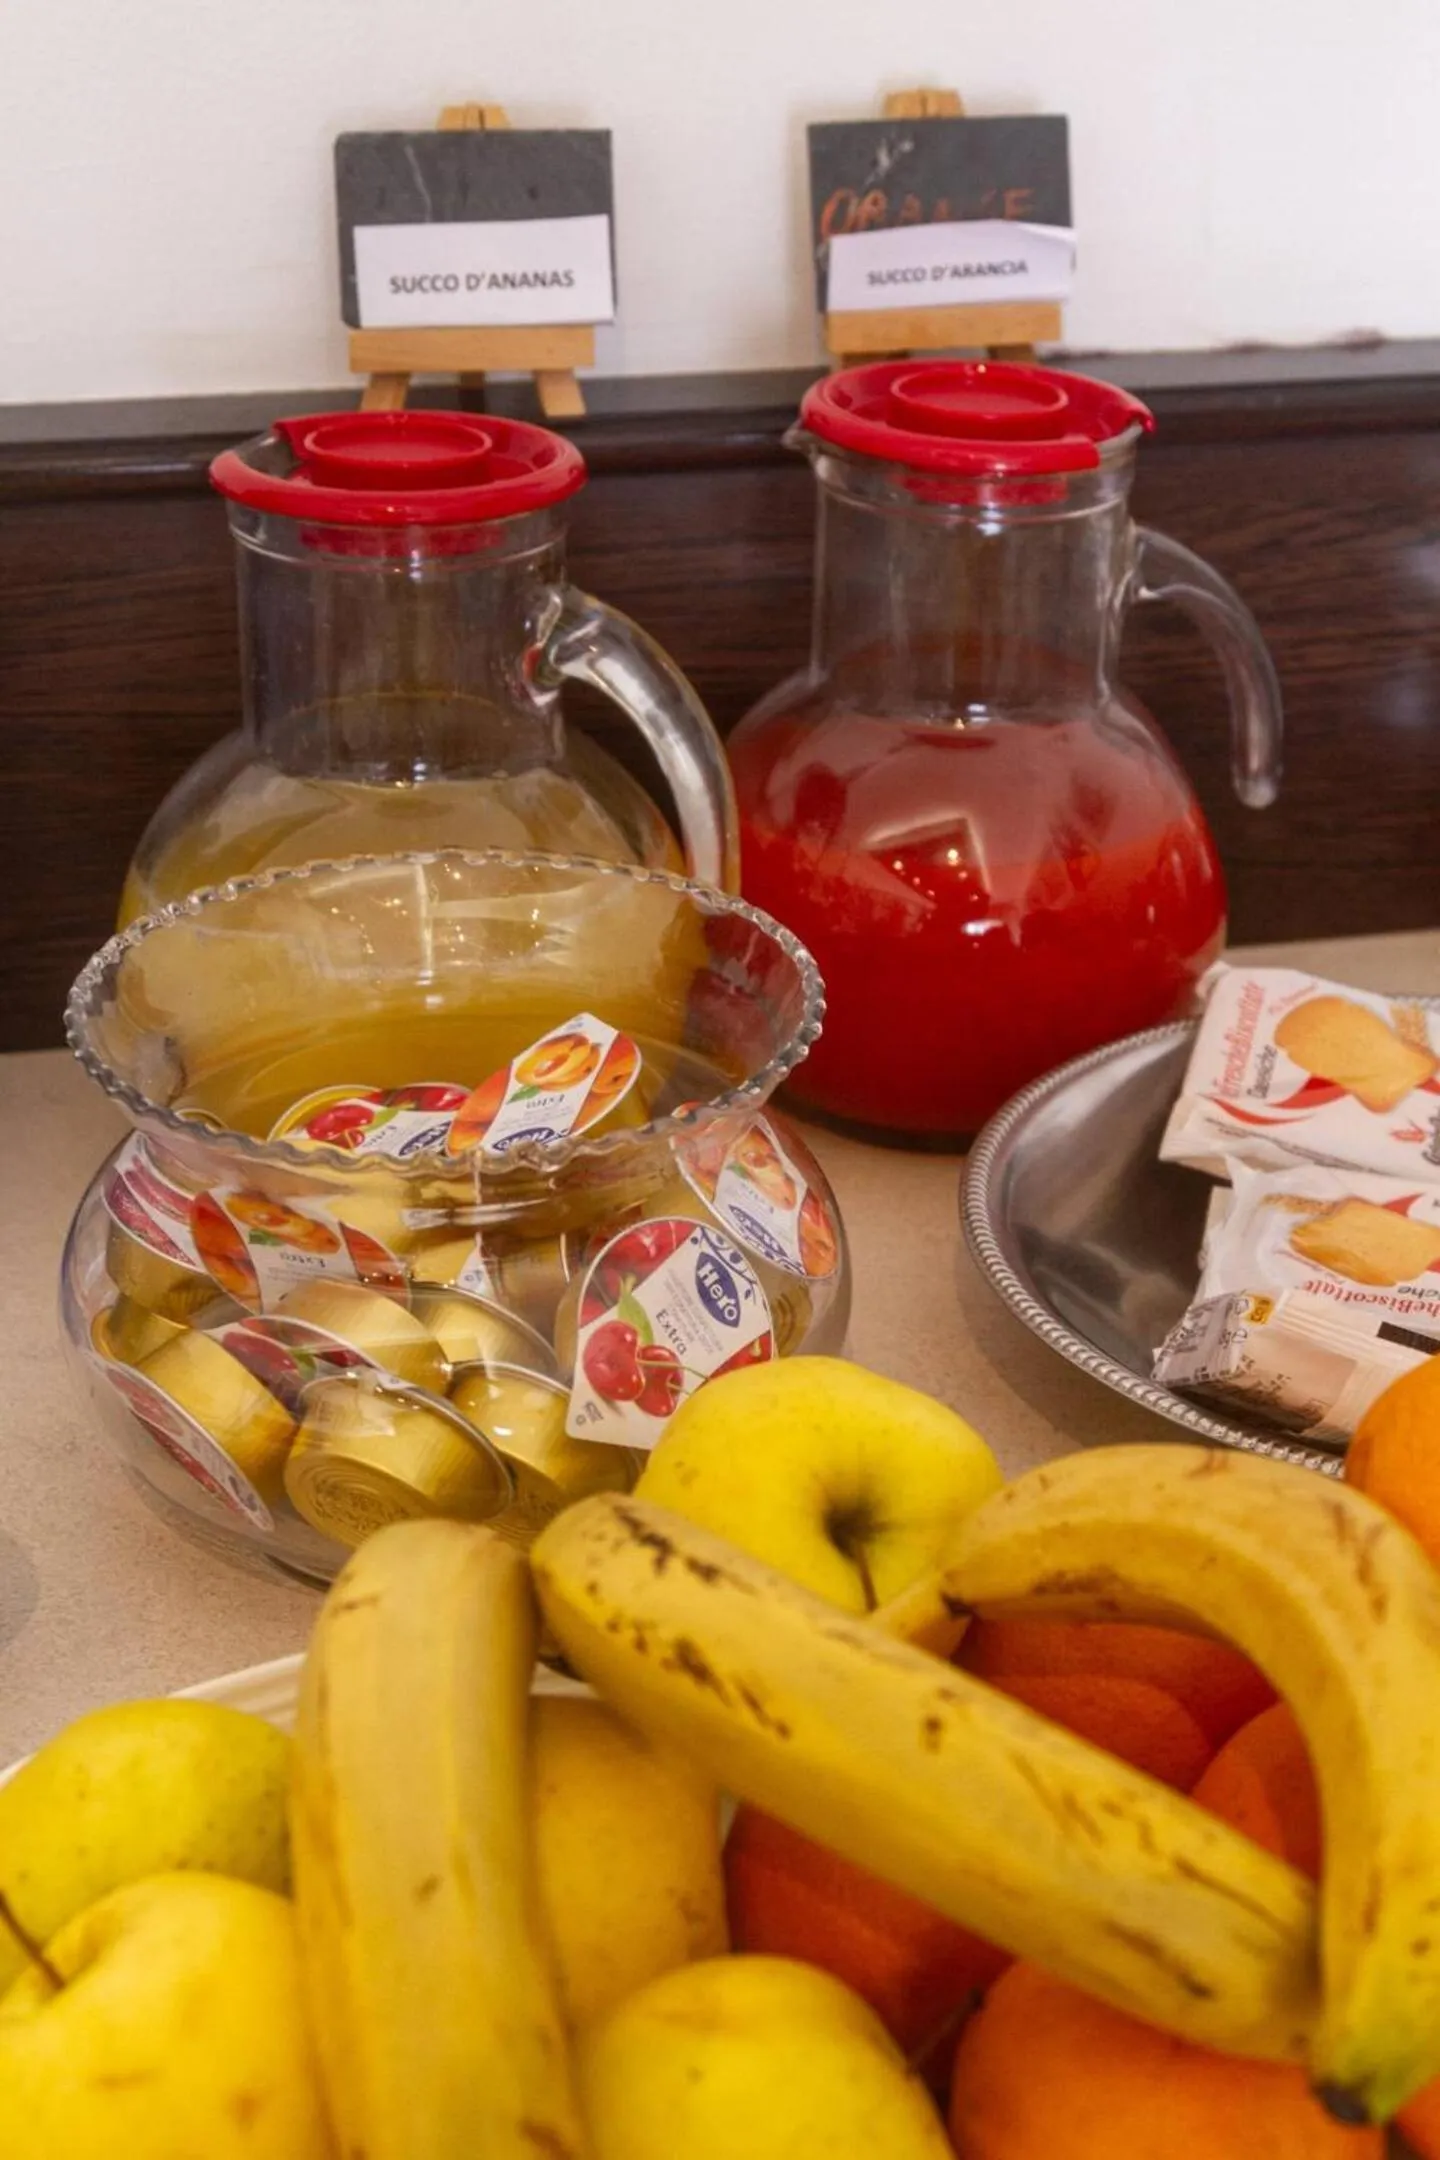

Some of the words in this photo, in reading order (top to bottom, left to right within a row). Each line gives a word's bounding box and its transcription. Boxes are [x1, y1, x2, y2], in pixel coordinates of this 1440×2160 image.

[389, 273, 459, 294] SUCCO
[465, 270, 575, 292] D'ANANAS
[867, 267, 926, 286] SUCCO
[931, 260, 1028, 282] D'ARANCIA
[697, 1261, 738, 1321] Hero
[655, 1309, 687, 1354] Extra
